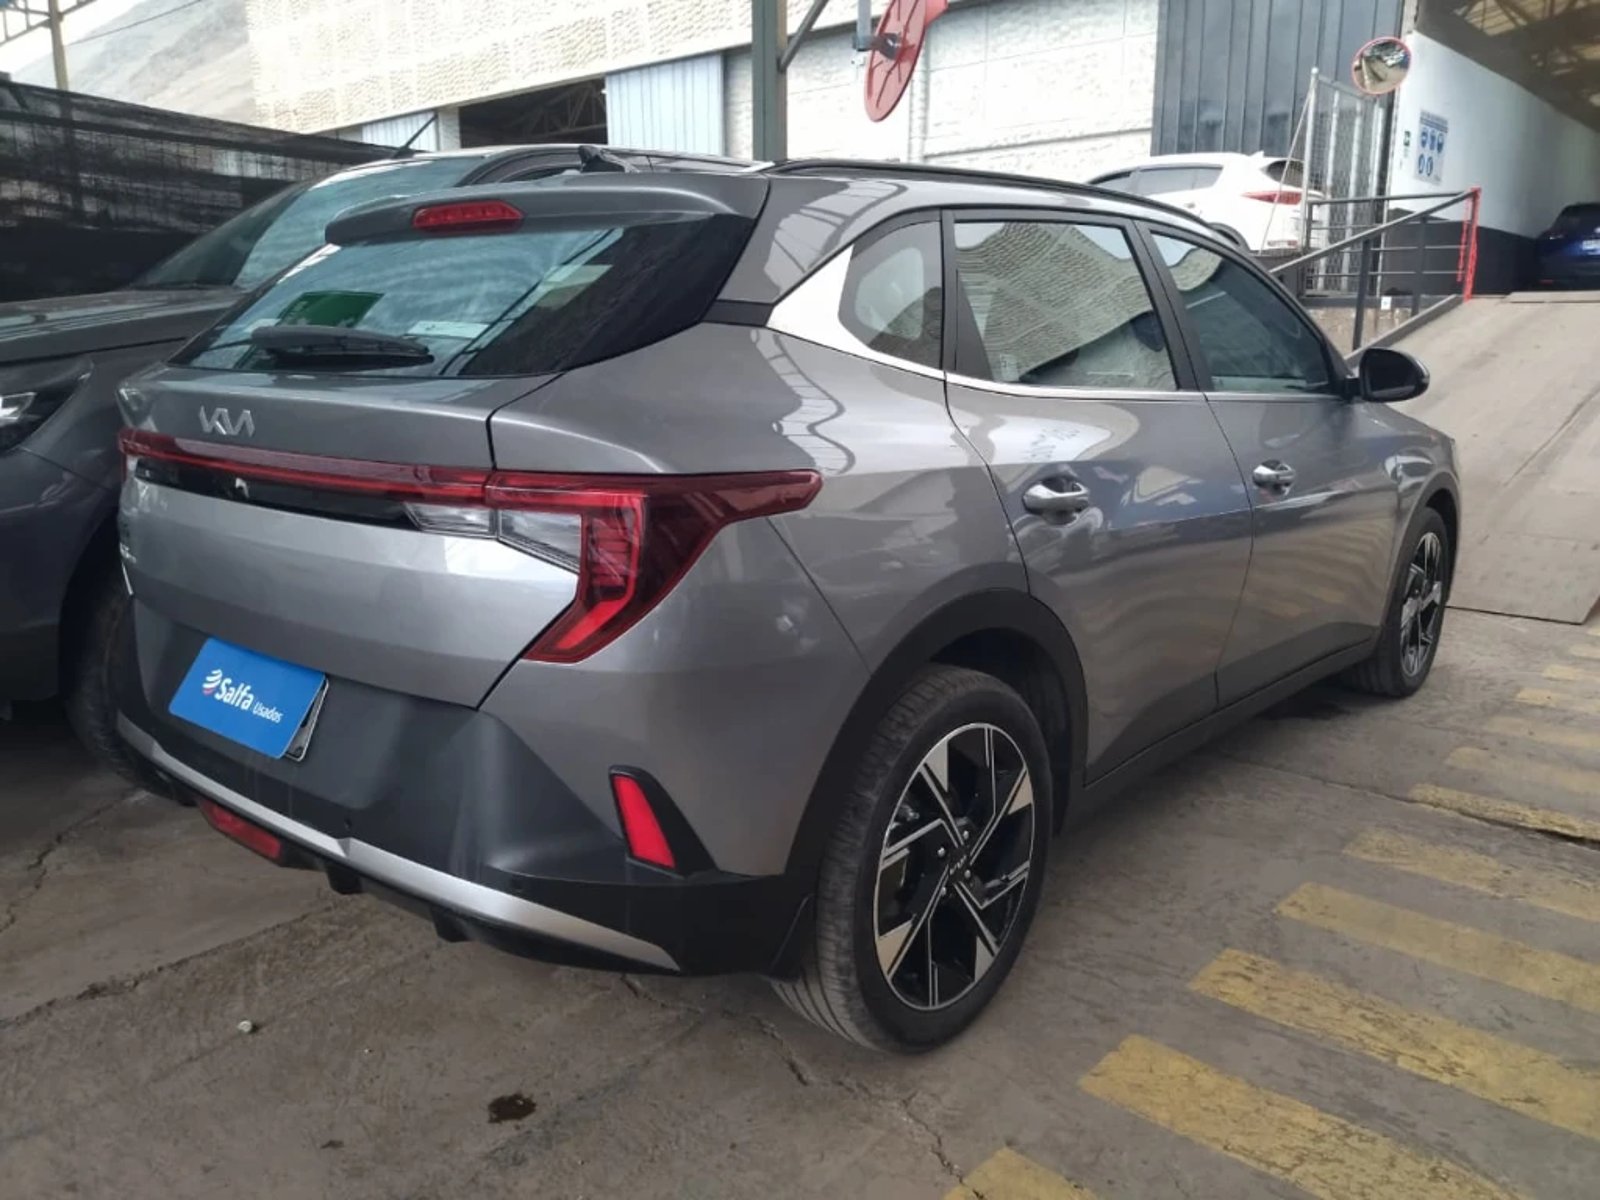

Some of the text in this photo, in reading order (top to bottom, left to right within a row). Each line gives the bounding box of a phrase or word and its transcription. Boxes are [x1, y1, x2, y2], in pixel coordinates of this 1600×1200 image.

[199, 405, 255, 437] KIA
[214, 678, 284, 724] Salfa Usados
